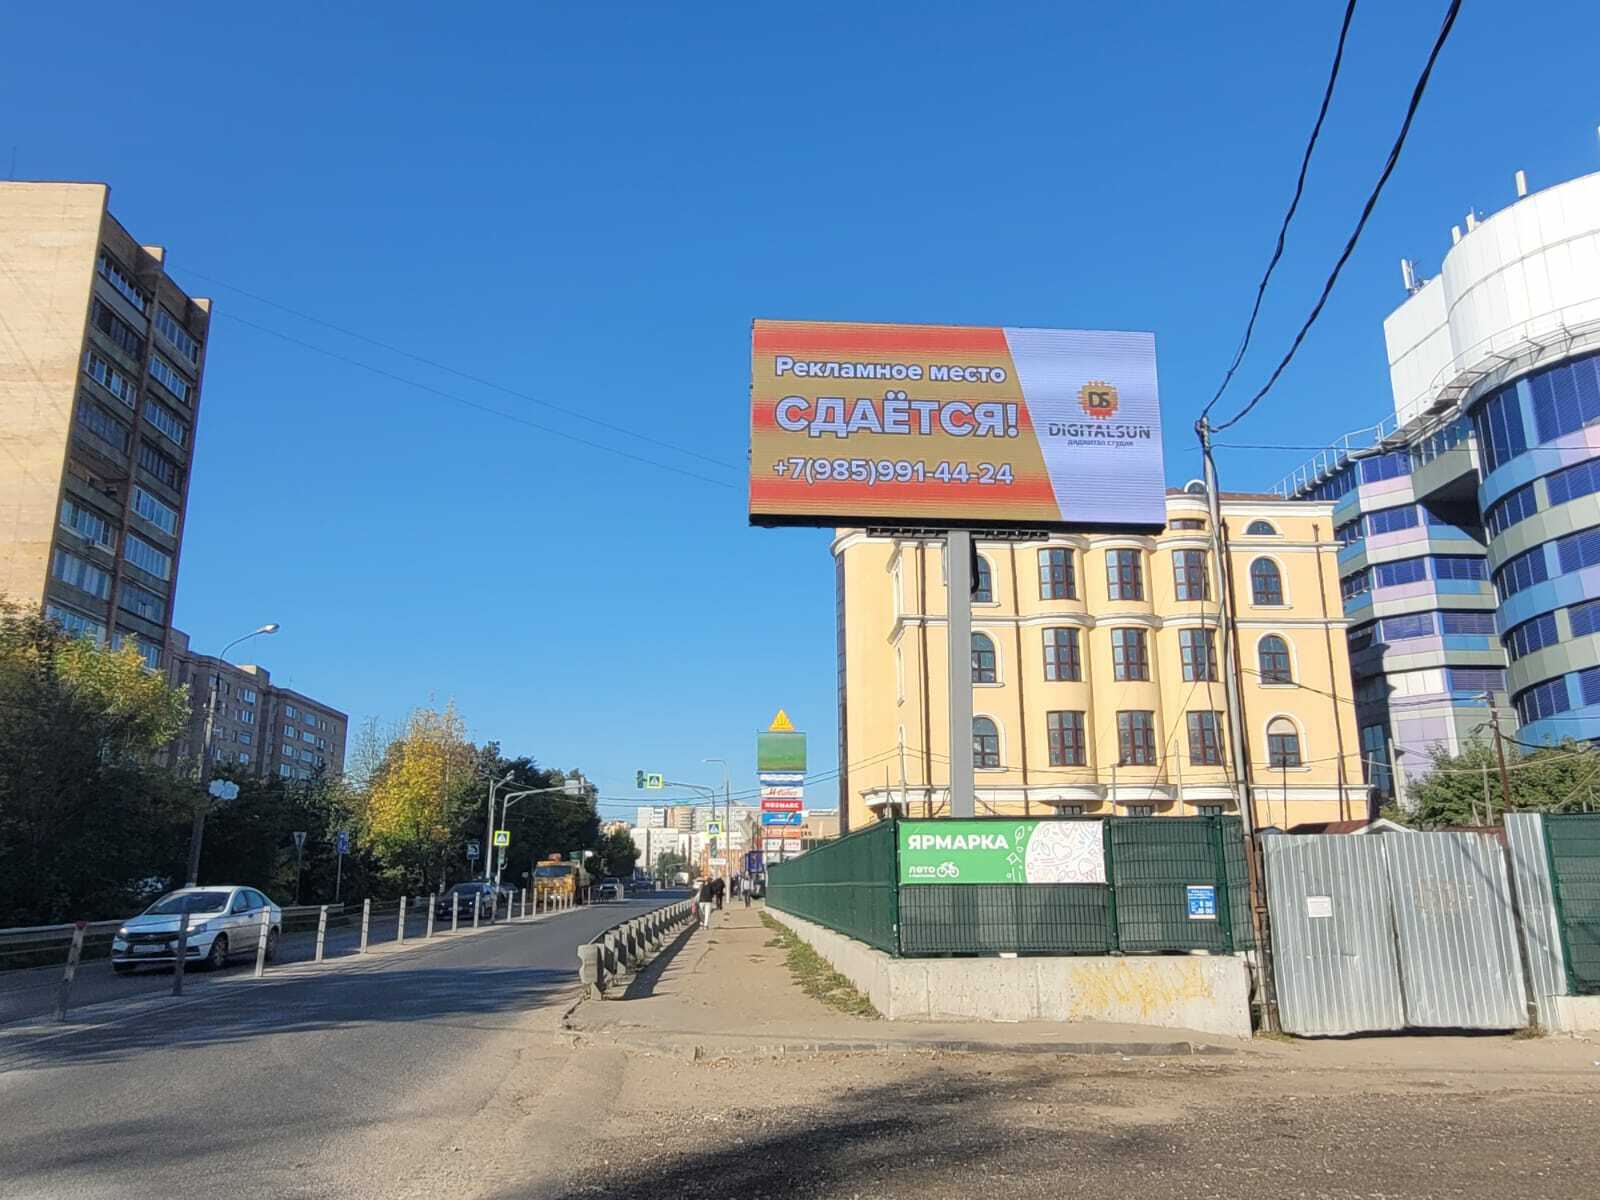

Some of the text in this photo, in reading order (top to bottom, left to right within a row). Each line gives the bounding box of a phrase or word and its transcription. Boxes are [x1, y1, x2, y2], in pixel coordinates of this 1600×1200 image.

[775, 355, 1007, 383] Рекламное место
[775, 390, 1020, 439] СДАЁТСЯ!
[773, 457, 1014, 487] +7(985)991-44-24
[907, 834, 1009, 850] ЯРМАРКА
